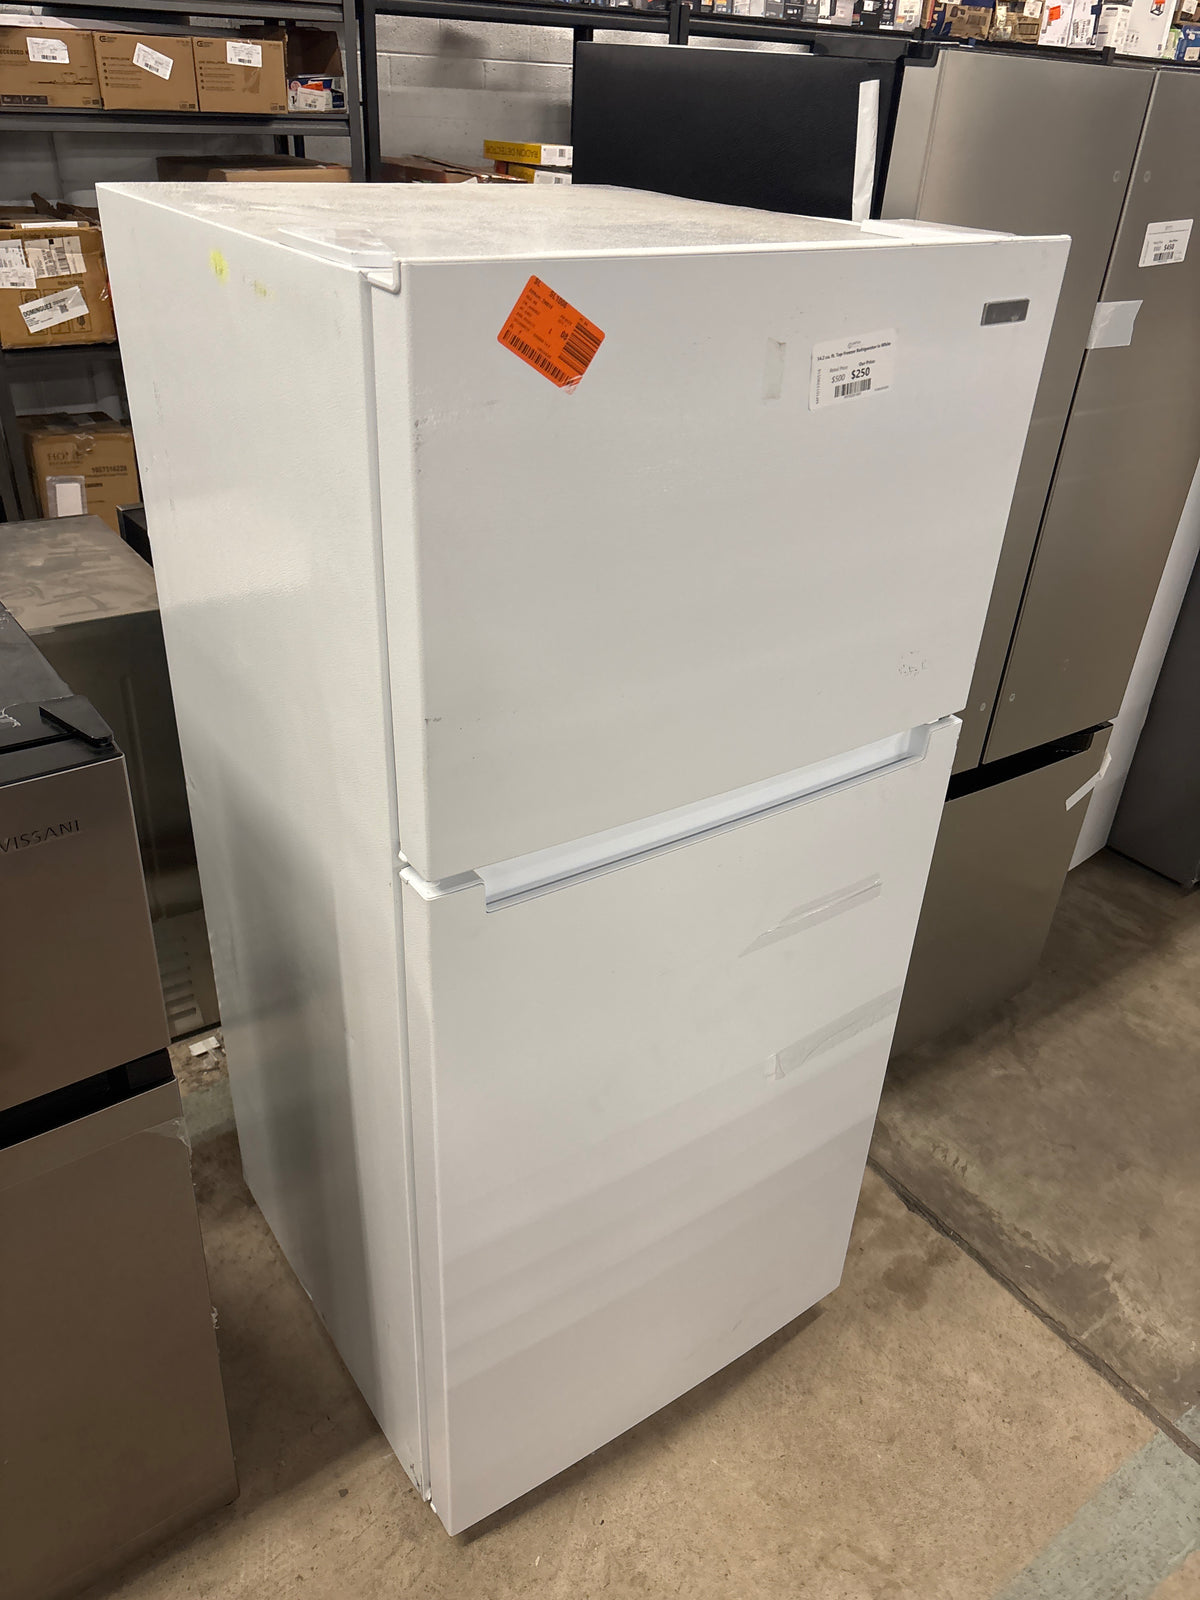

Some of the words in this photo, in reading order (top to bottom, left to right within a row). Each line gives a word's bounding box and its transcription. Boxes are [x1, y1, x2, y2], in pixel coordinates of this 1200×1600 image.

[22, 302, 53, 318] DOMINGUEZ
[831, 373, 846, 384] $500
[851, 366, 871, 380] $250
[0, 820, 80, 853] VISSANI
